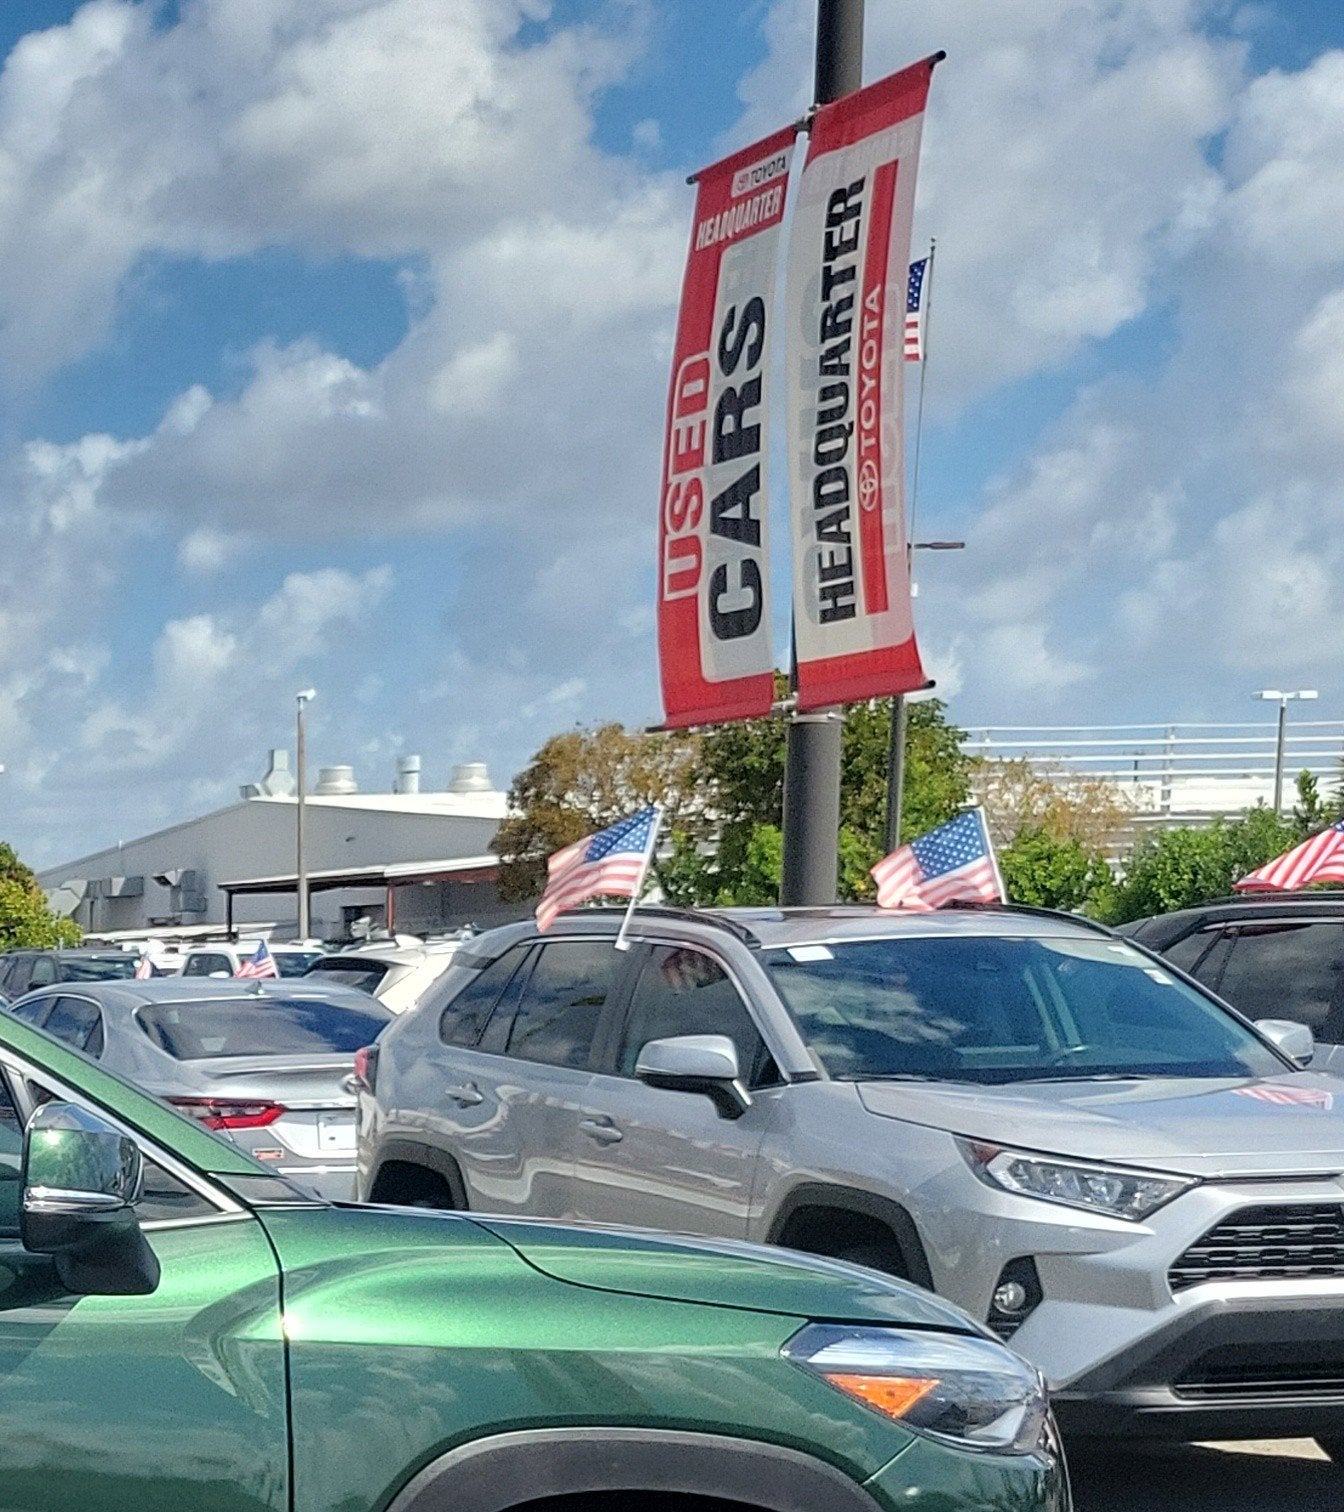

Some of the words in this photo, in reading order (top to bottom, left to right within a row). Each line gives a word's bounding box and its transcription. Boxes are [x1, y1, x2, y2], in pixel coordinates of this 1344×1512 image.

[695, 184, 783, 253] HEADQUARTER
[752, 155, 787, 185] TOYOTA
[664, 350, 710, 602] USED
[708, 296, 765, 641] CARS
[813, 174, 867, 625] HEADQUARTER
[860, 282, 883, 458] TOYOTA
